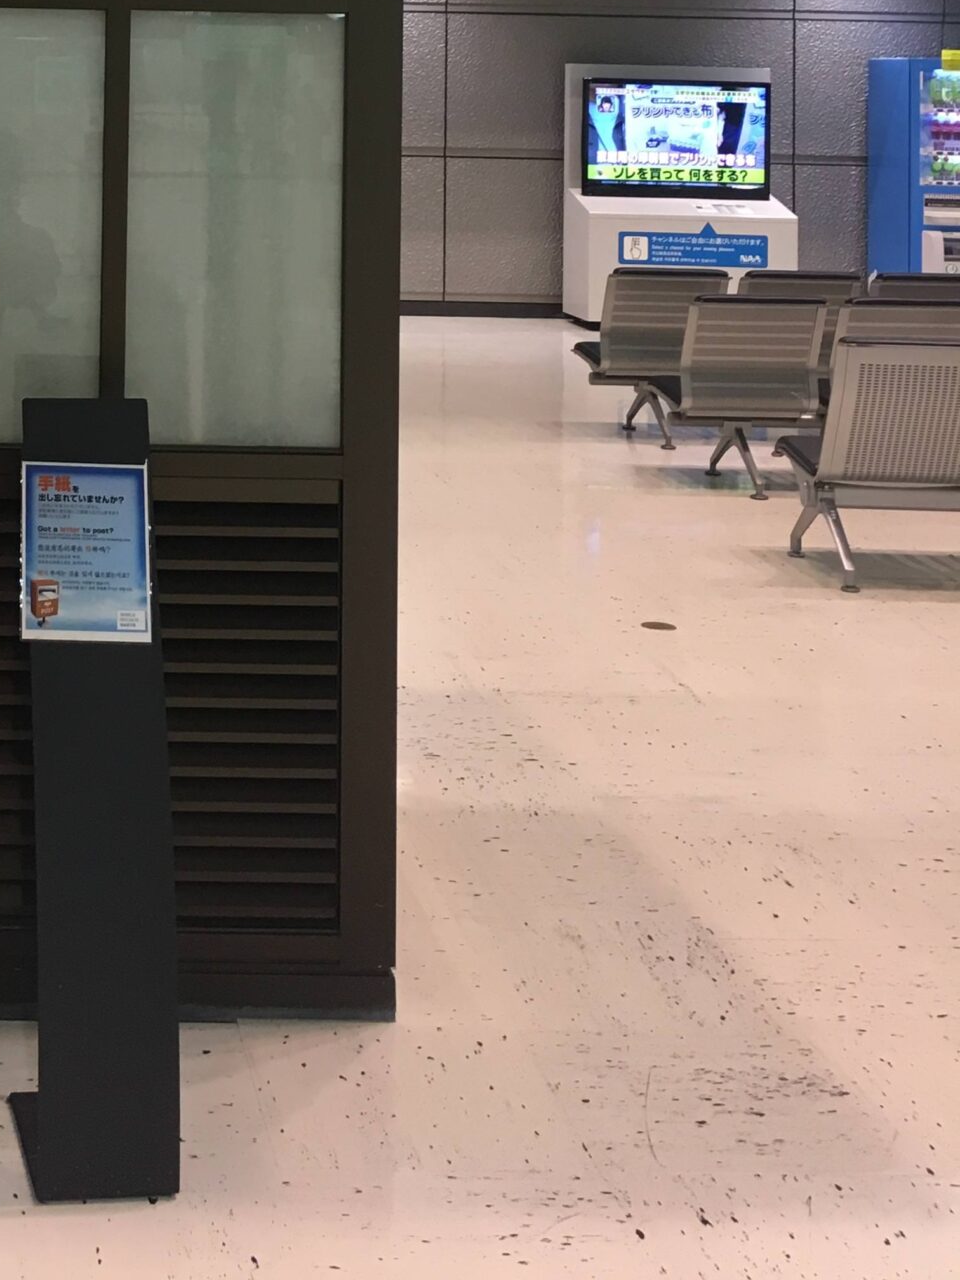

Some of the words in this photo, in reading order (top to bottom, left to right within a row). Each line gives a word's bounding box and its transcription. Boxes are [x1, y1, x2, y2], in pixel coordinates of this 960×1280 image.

[614, 167, 684, 180] ソレを買って
[689, 169, 749, 182] 何をする?
[38, 494, 124, 505] 出し忘れていませんか?
